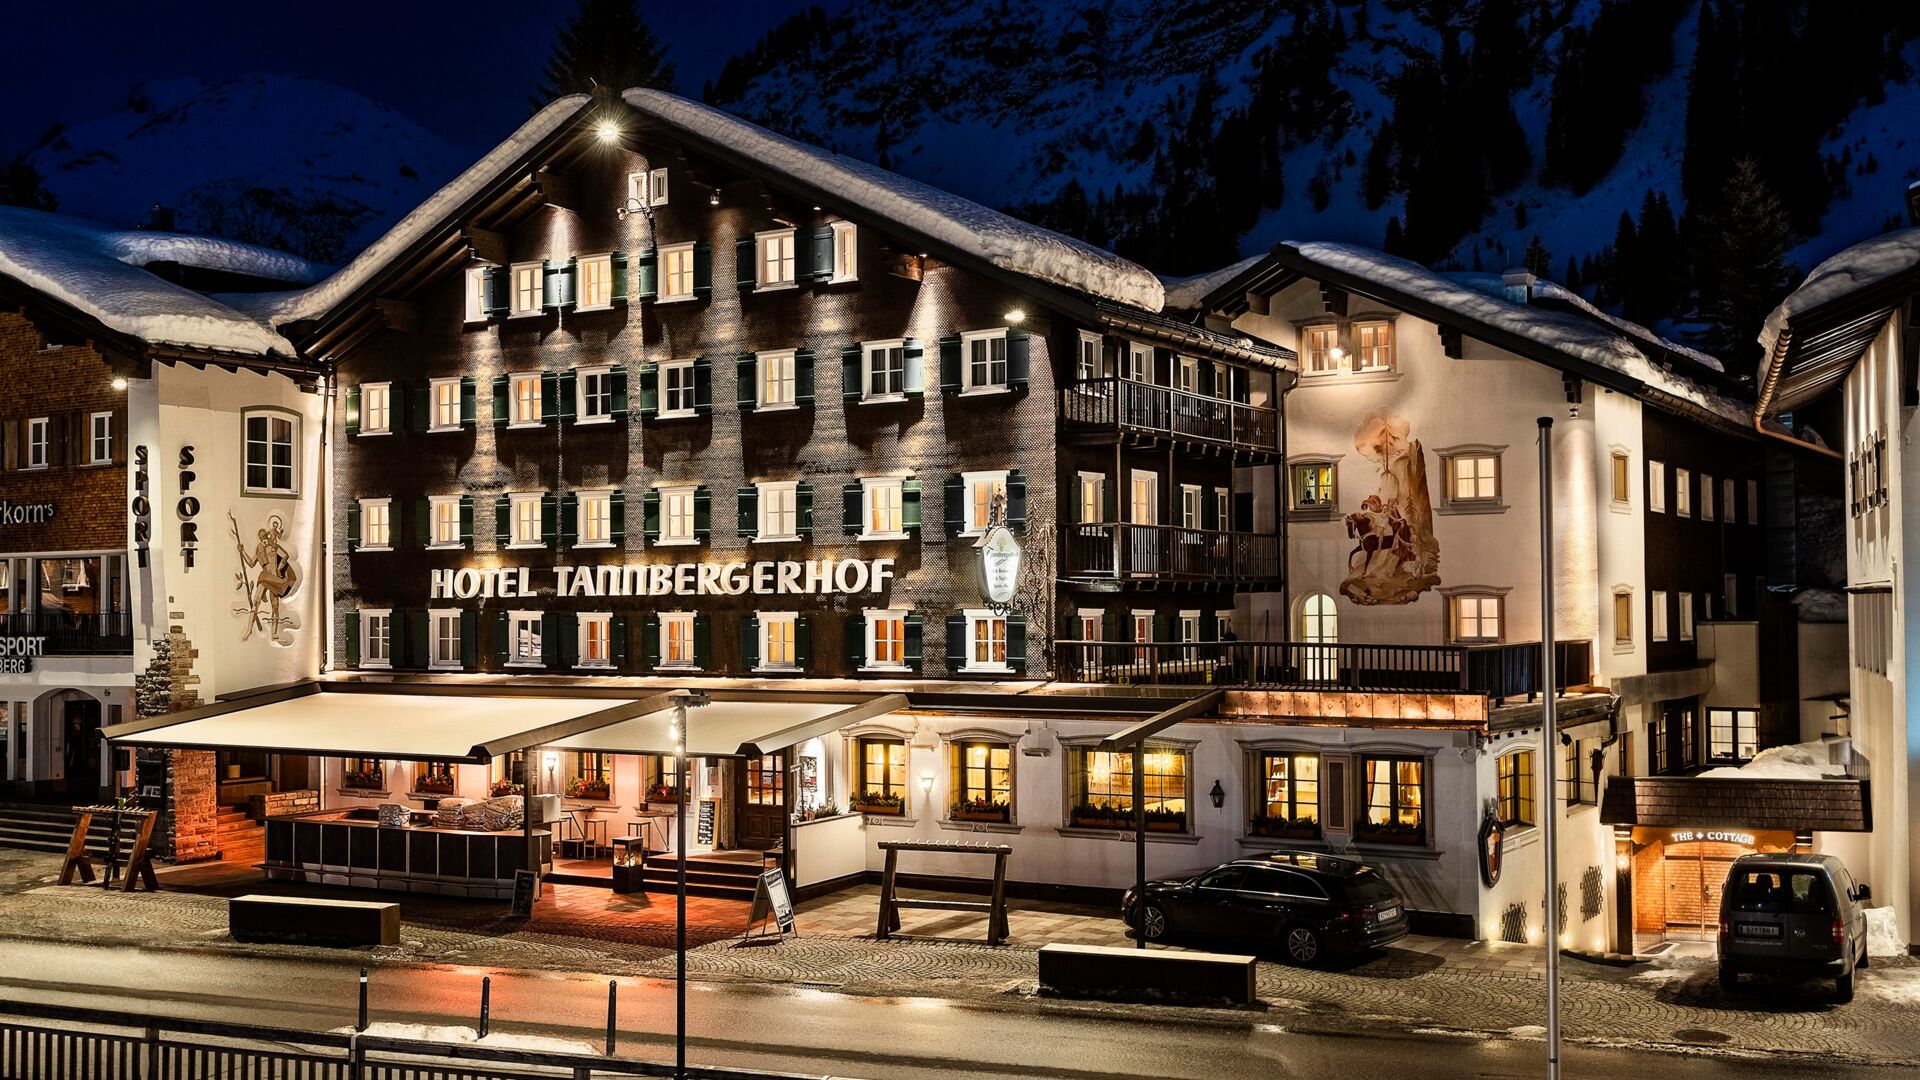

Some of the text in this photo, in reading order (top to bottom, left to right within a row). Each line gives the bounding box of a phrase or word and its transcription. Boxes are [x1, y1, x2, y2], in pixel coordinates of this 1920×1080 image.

[0, 501, 54, 524] korn's
[132, 445, 149, 568] SPORT
[178, 446, 200, 568] SPORT
[430, 566, 537, 599] HOTEL
[1672, 832, 1755, 844] THE COTTAGE
